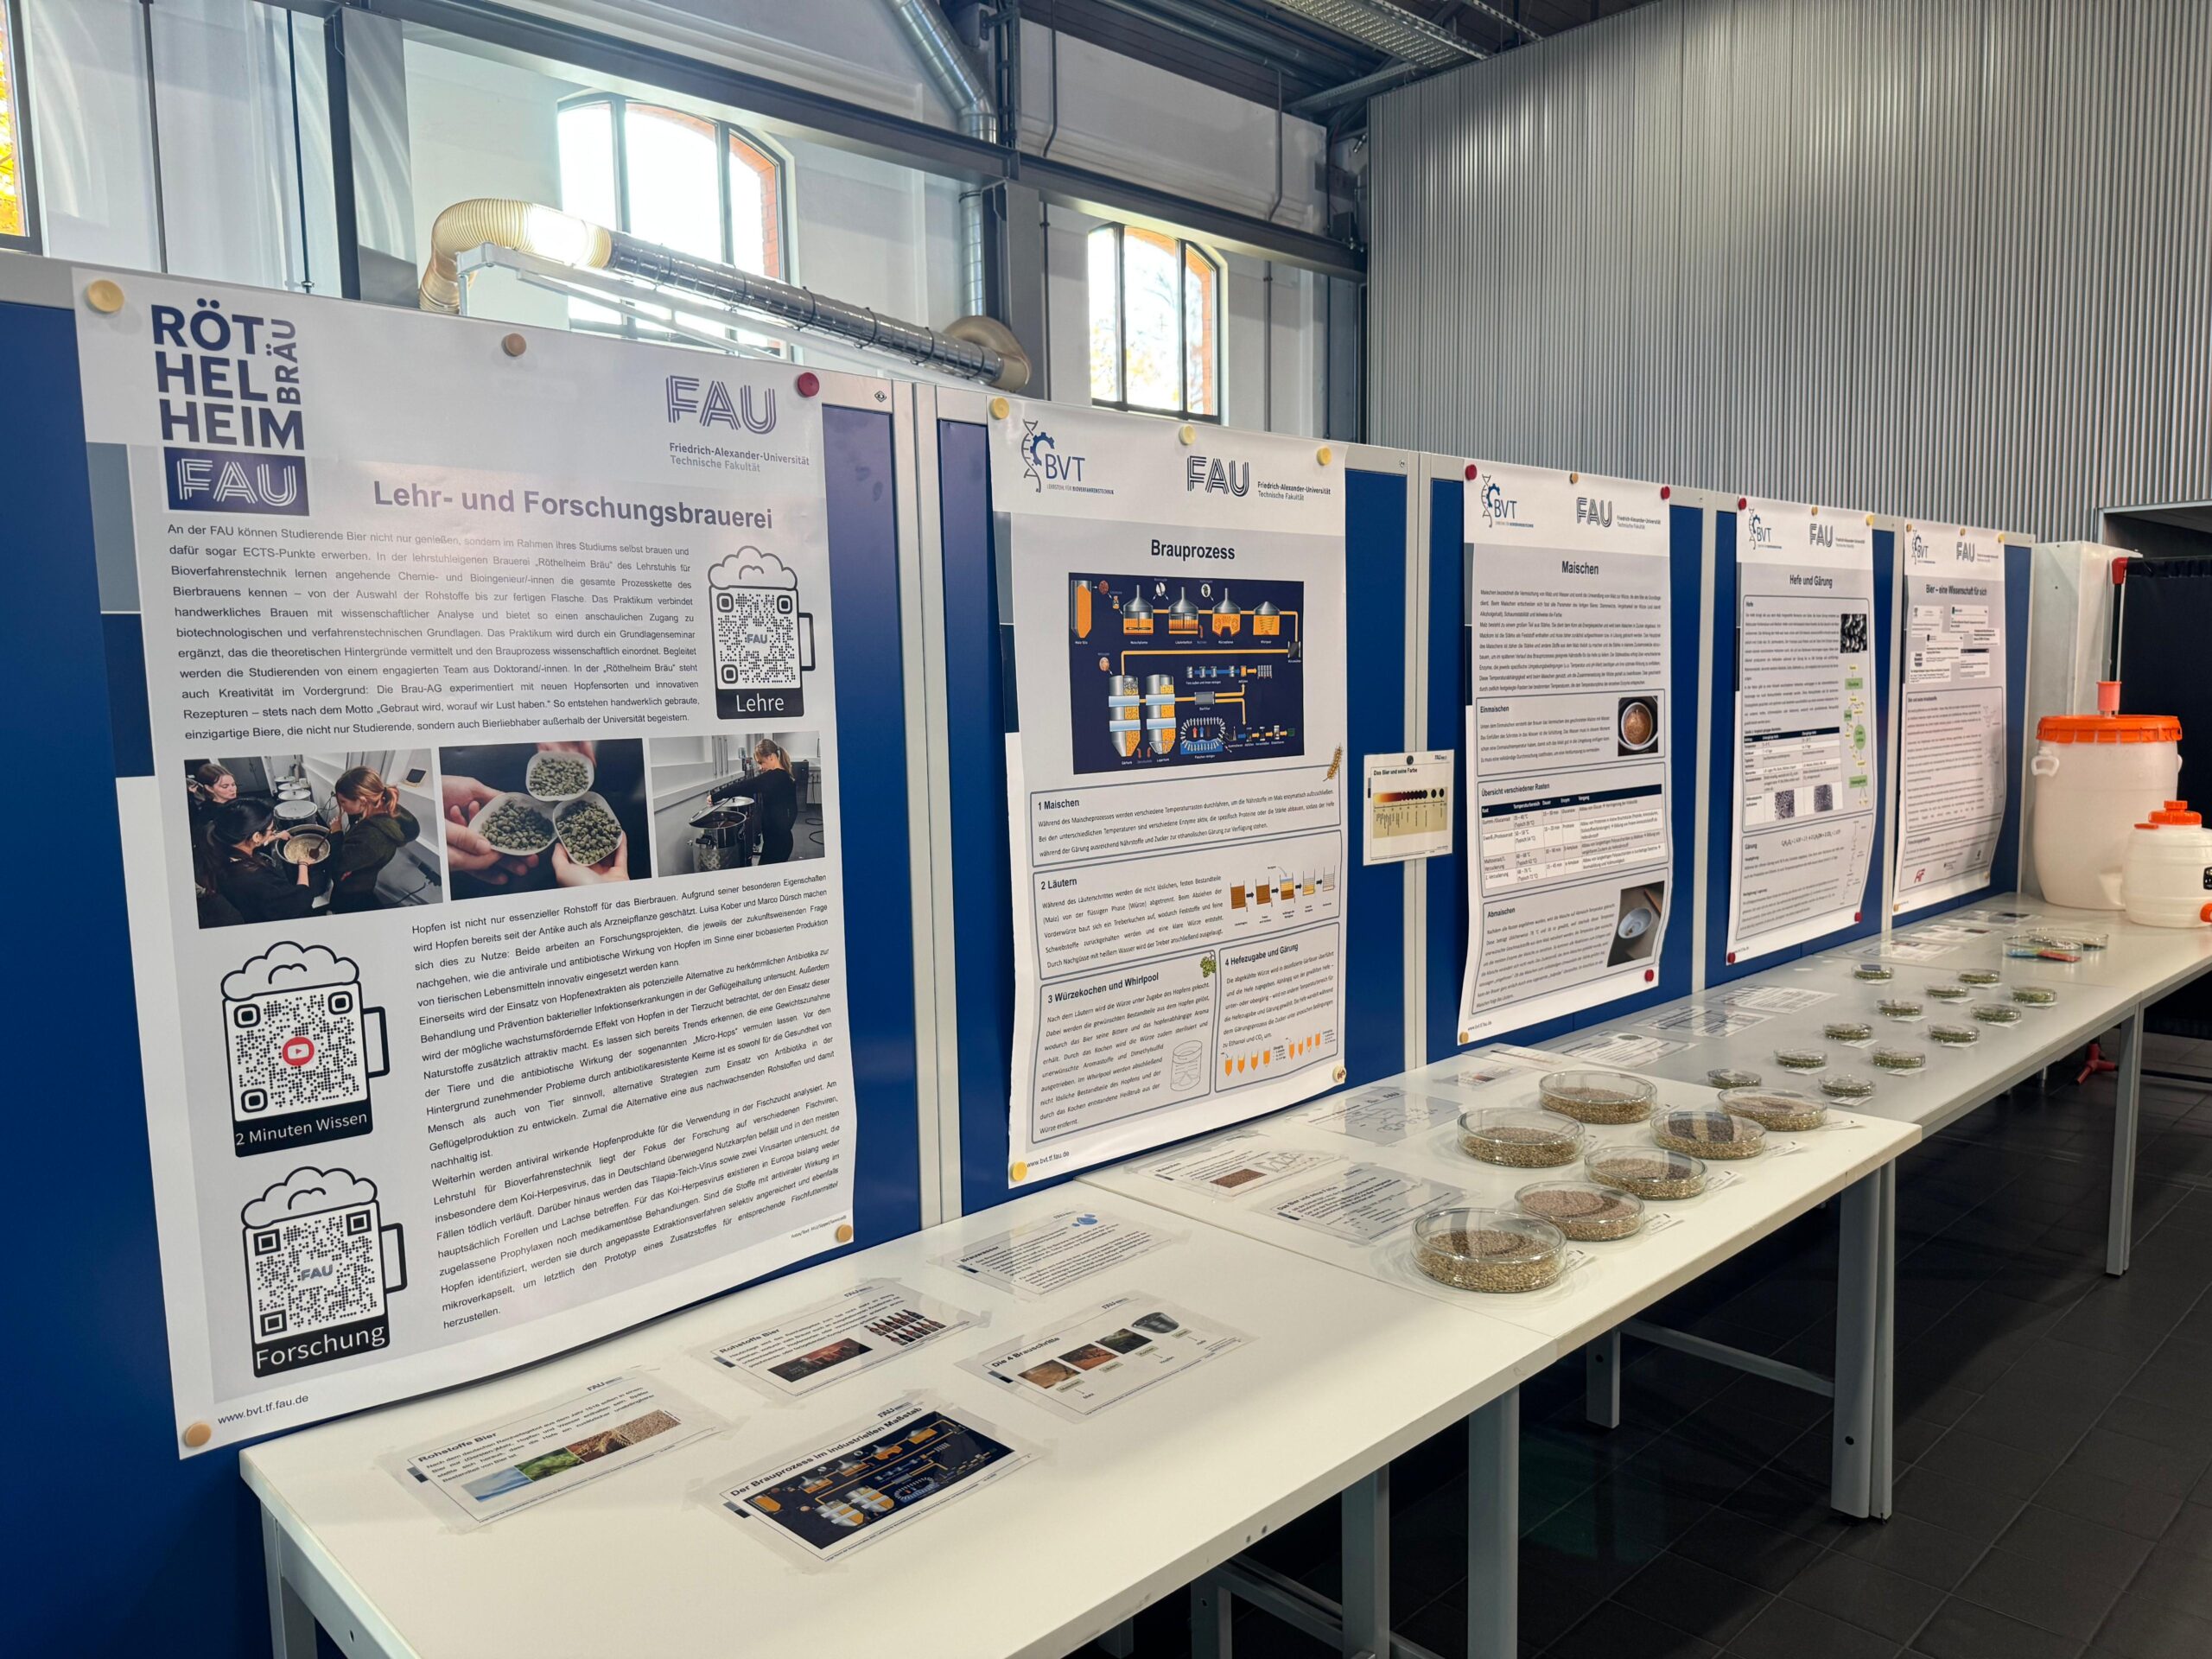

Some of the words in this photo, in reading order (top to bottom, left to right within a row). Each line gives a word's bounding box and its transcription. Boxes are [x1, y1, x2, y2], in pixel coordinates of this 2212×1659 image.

[151, 298, 264, 355] RÖT
[265, 318, 302, 406] BRÄU
[155, 350, 268, 402] HEL
[665, 374, 778, 435] FAU
[159, 398, 305, 451] HEIM
[669, 442, 810, 466] Friedrich-Alexander-Universität
[670, 454, 722, 468] Technische
[724, 460, 760, 473] Fakultät
[1045, 454, 1086, 482] BVT
[1186, 454, 1250, 498] FAU
[177, 457, 298, 508] FAU
[1257, 480, 1331, 496] Friedrich-Alexander-Universität
[373, 480, 453, 508] Lehr-
[461, 489, 515, 512] und
[524, 490, 772, 530] Forschungsbrauerei
[1258, 490, 1285, 499] Technische
[1285, 493, 1304, 501] Fakultät
[1494, 499, 1517, 519] BVT
[1576, 496, 1613, 528] FAU
[168, 524, 184, 534] An
[188, 524, 207, 535] der
[210, 525, 234, 537] FAU
[238, 526, 278, 538] können
[281, 528, 344, 541] Studierende
[346, 531, 367, 541] Bier
[370, 532, 394, 543] nicht
[396, 535, 412, 543] nur
[414, 535, 461, 546] genießen,
[463, 537, 501, 548] sondern
[503, 537, 514, 547] im
[517, 538, 554, 550] Rahmen
[579, 541, 618, 552] Studiums
[620, 544, 644, 554] selbst
[645, 545, 673, 555] brauen
[675, 548, 690, 556] und
[1758, 526, 1771, 543] BVT
[1809, 523, 1833, 548] FAU
[1151, 538, 1236, 563] Brauprozess
[1916, 545, 1929, 559] BVT
[1956, 542, 1975, 563] FAU
[1561, 560, 1599, 575] Maischen
[1789, 574, 1802, 586] Hefe
[1802, 575, 1813, 586] und
[1814, 575, 1833, 589] Gärung
[1925, 584, 1935, 594] Bier
[1939, 585, 1948, 594] eine
[1948, 585, 1974, 595] Wissenschaft
[175, 607, 261, 617] handwerkliches
[270, 607, 308, 618] Brauen
[317, 607, 333, 618] mit
[341, 608, 429, 619] wissenschaftlicher
[437, 609, 474, 621] Analyse
[481, 610, 499, 620] und
[505, 610, 531, 620] bietet
[555, 612, 578, 620] einen
[585, 612, 643, 621] anschaulichen
[649, 613, 679, 624] Zugang
[747, 633, 768, 645] FAU
[736, 693, 785, 712] Lehre
[1480, 704, 1510, 714] Einmaischen
[1481, 786, 1503, 797] Übersicht
[1504, 785, 1535, 794] verschiedener
[1038, 801, 1041, 810] 1
[1044, 798, 1080, 810] Maischen
[1040, 880, 1046, 891] 2
[1047, 878, 1077, 889] Läutern
[412, 923, 446, 935] Hopfen
[450, 920, 461, 930] ist
[465, 917, 487, 928] nicht
[491, 916, 505, 925] nur
[509, 909, 560, 922] essenzieller
[563, 902, 598, 915] Rohstoff
[601, 901, 613, 911] für
[615, 899, 631, 909] das
[633, 894, 678, 906] Bierbrauen.
[681, 888, 715, 900] Aufgrund
[717, 887, 740, 895] seiner
[741, 881, 781, 893] besonderen
[783, 874, 826, 887] Eigenschaften
[1487, 906, 1516, 919] Abmaischen
[1224, 957, 1230, 966] 4
[1230, 951, 1267, 966] Hefezugabe
[1268, 947, 1279, 957] und
[1280, 944, 1299, 955] Gärung
[1048, 995, 1052, 1004] 3
[1054, 985, 1107, 1002] Würzekochen
[1109, 979, 1123, 991] und
[1124, 971, 1159, 987] Whirlpool
[1047, 1014, 1060, 1023] Nach
[1074, 1008, 1094, 1018] Läutern
[1095, 1004, 1106, 1013] wird
[1146, 992, 1163, 1001] Zugabe
[236, 1133, 245, 1147] 2
[249, 1123, 312, 1143] Minuten
[315, 1113, 367, 1132] Wissen
[1039, 1125, 1056, 1135] Würze
[1057, 1118, 1078, 1129] entfernt.
[442, 1285, 515, 1312] mikroverkapselt,
[523, 1280, 537, 1289] um
[543, 1267, 575, 1283] letztlich
[582, 1262, 597, 1271] den
[604, 1249, 637, 1264] Prototyp
[643, 1240, 664, 1252] eines
[670, 1224, 717, 1244] Zusatzstoffes
[722, 1217, 732, 1227] für
[738, 1200, 786, 1222] entsprechende
[791, 1180, 838, 1203] Fischfuttermittel
[300, 1264, 334, 1281] FAU
[443, 1308, 500, 1330] herzustellen.
[256, 1325, 385, 1370] Forschung
[719, 1335, 761, 1354] Rohstoffe
[761, 1327, 780, 1338] Bier
[992, 1358, 1007, 1368] Die
[1013, 1336, 1060, 1358] Brauschritte
[218, 1395, 308, 1425] www.bvt.tf.fau.de
[417, 1440, 474, 1463] Rohstoffe
[474, 1432, 498, 1444] Bier
[730, 1484, 750, 1497] Der
[750, 1457, 814, 1488] Brauprozess
[813, 1449, 828, 1459] im
[828, 1426, 885, 1453] industriellen
[883, 1407, 923, 1428] Maßstab
